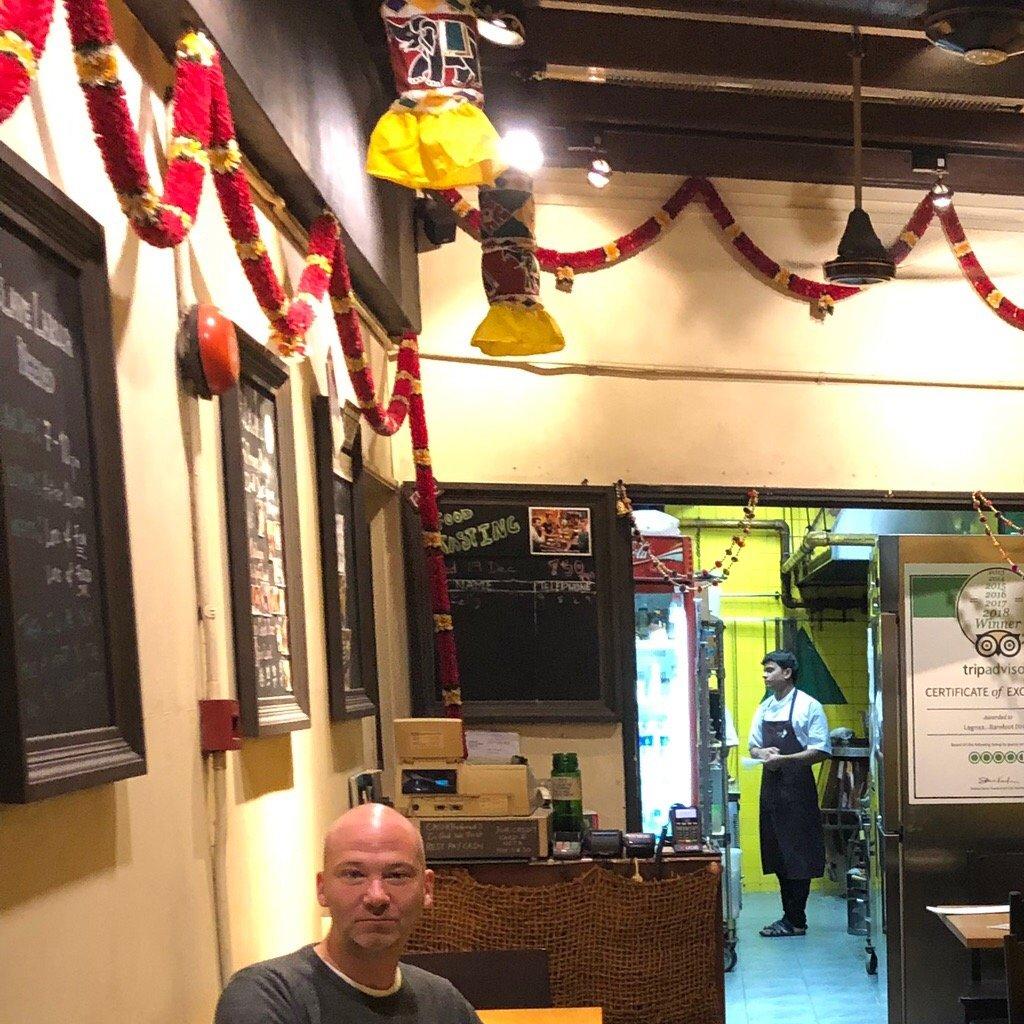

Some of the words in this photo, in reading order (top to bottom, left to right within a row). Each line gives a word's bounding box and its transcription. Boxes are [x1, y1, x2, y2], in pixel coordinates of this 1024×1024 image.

[985, 591, 1007, 599] 2016
[985, 600, 1007, 608] 2017
[982, 608, 1010, 618] 2018
[975, 618, 1022, 630] Winner
[925, 687, 989, 697] CERTIFICATE
[991, 686, 1002, 698] of
